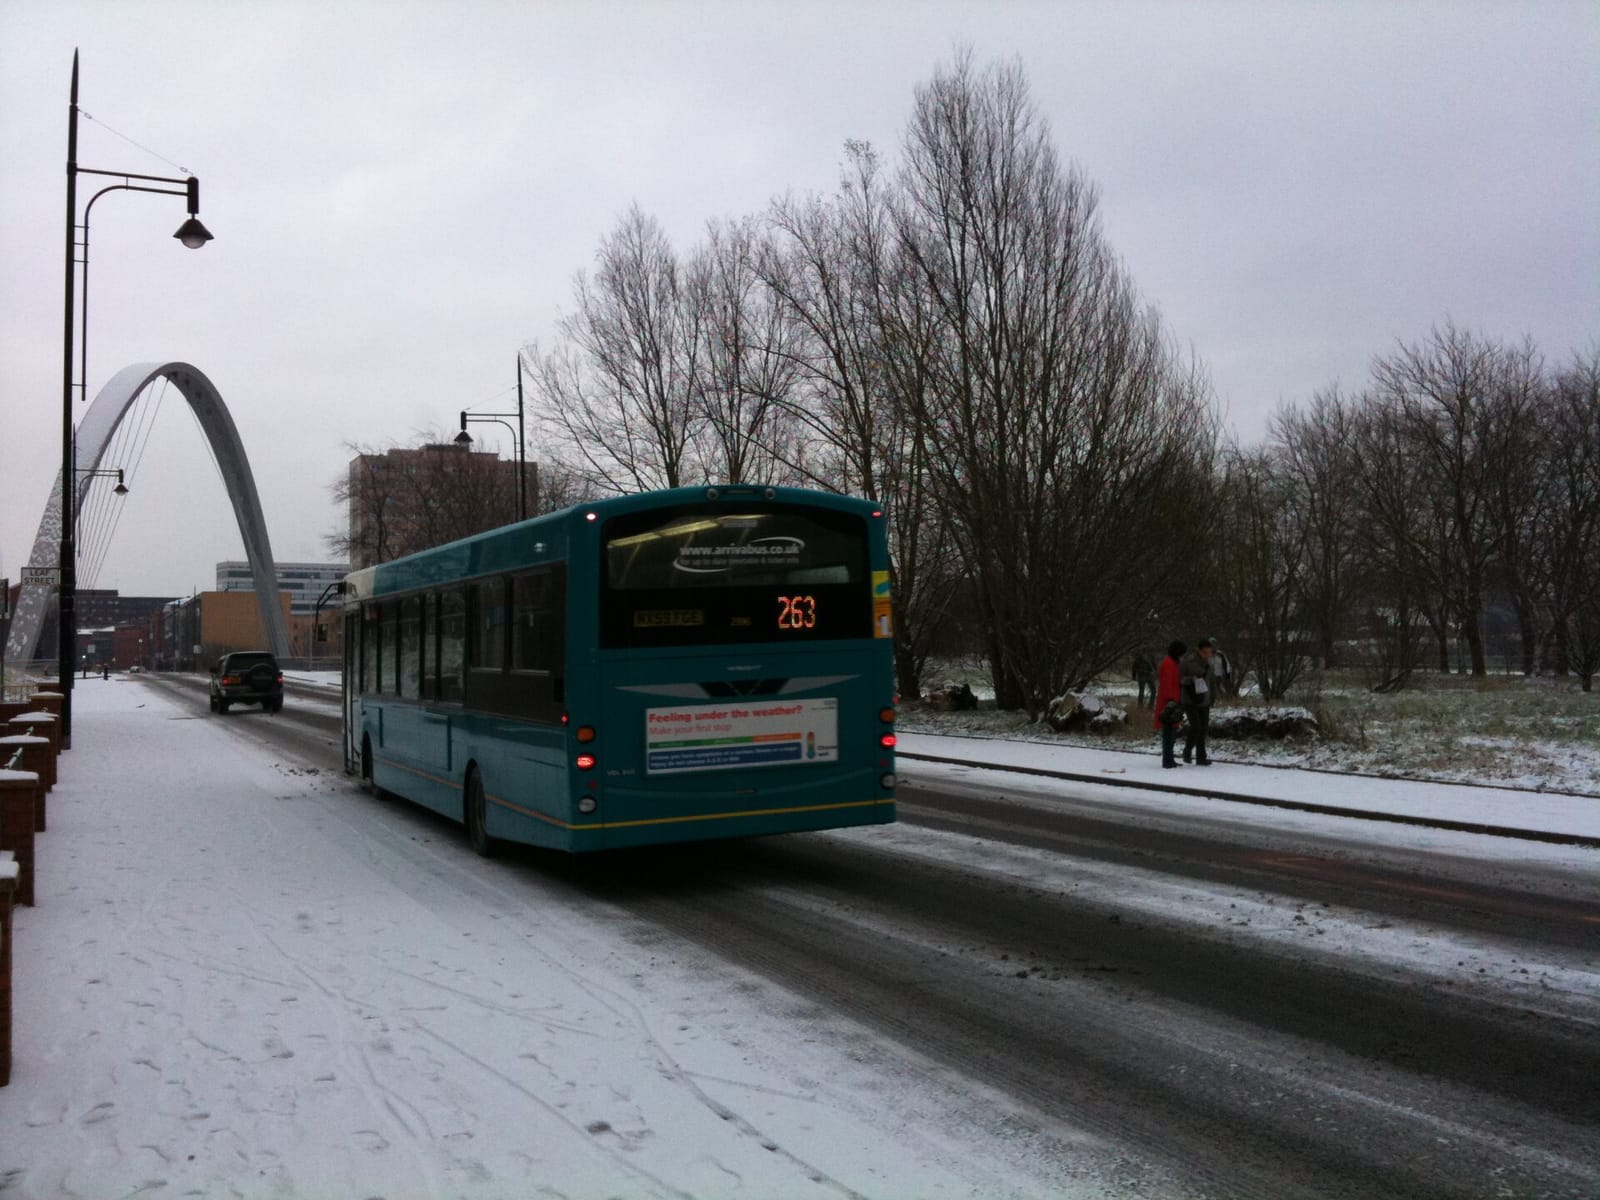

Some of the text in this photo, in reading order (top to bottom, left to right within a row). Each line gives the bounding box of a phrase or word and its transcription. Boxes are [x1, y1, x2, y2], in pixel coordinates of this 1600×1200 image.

[680, 542, 800, 556] www.arrivabus.co.uk
[777, 595, 816, 630] 263
[649, 711, 692, 723] Feeling
[695, 710, 729, 721] under
[731, 708, 749, 719] the
[752, 704, 803, 718] weather?
[649, 726, 673, 735] Make
[674, 726, 693, 737] your
